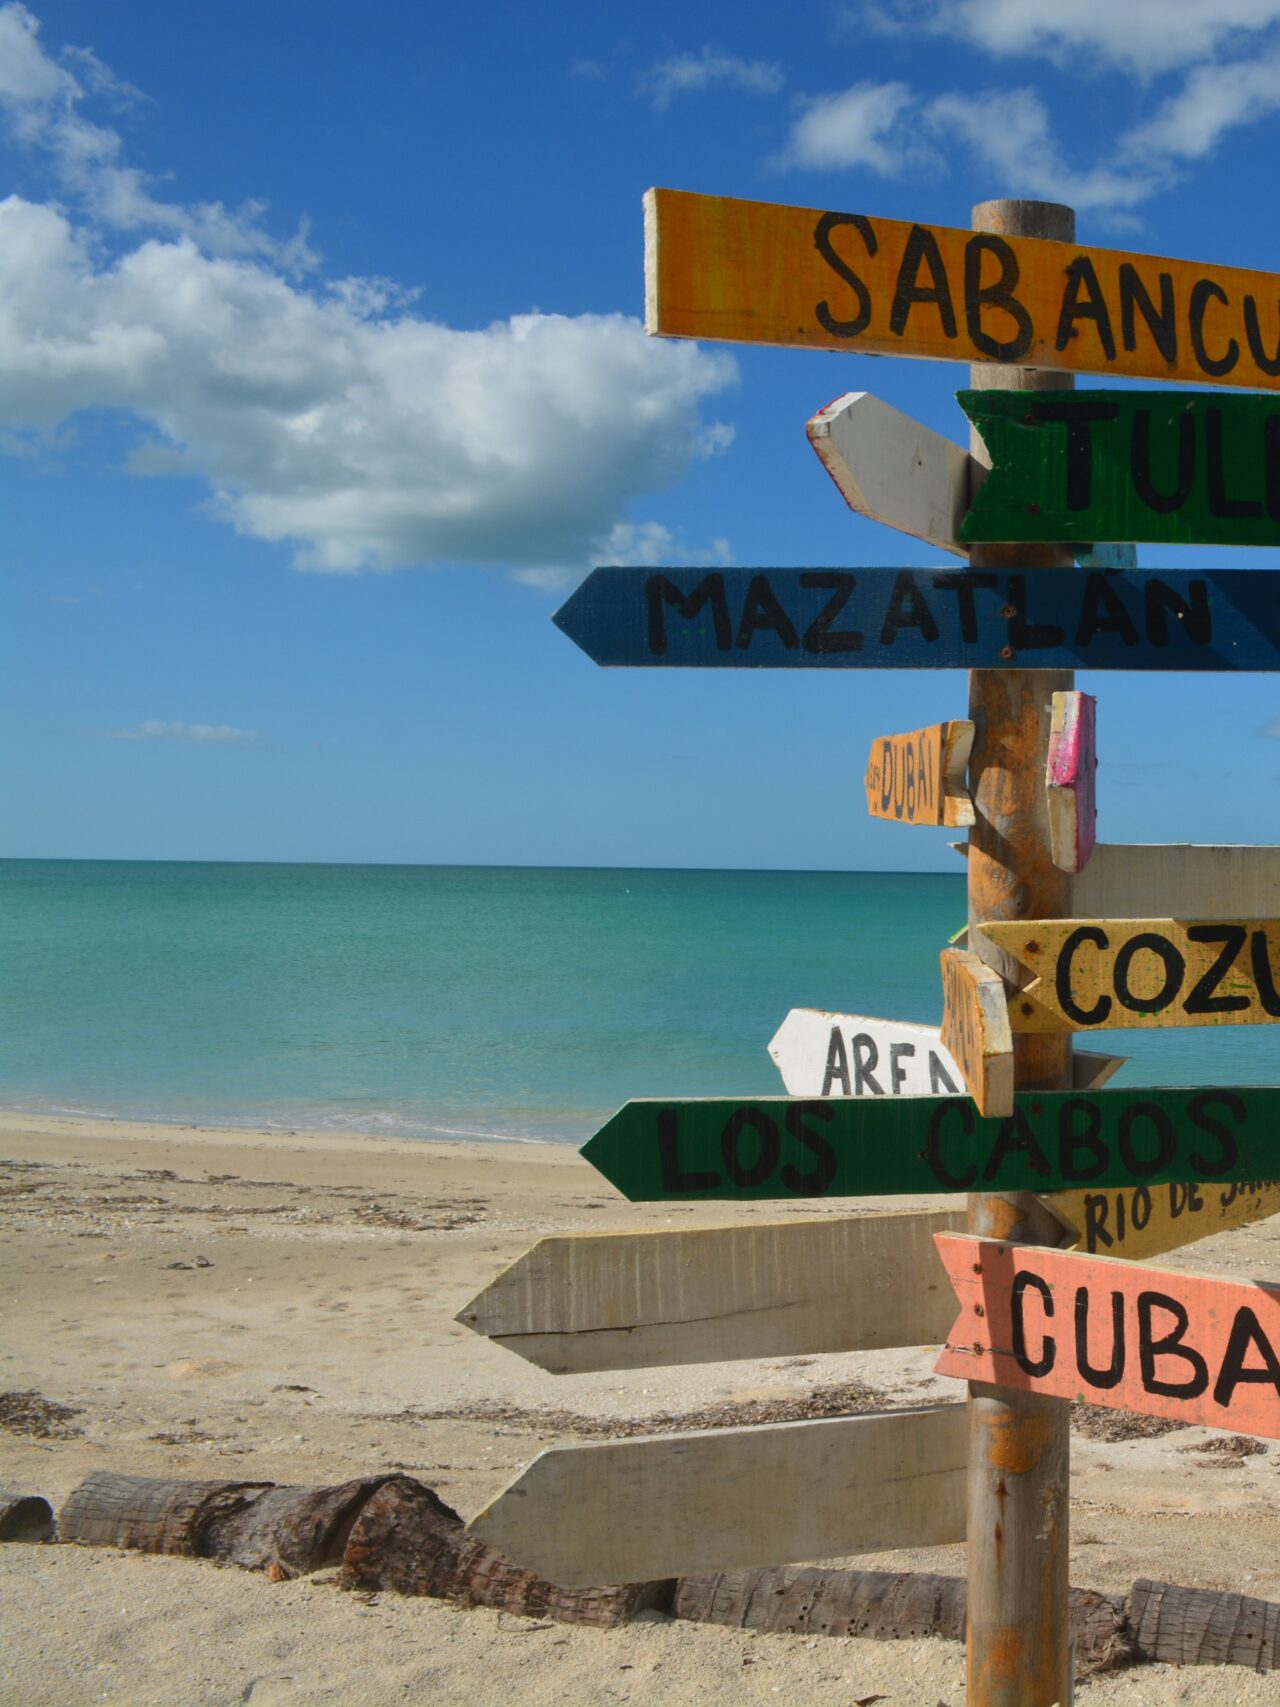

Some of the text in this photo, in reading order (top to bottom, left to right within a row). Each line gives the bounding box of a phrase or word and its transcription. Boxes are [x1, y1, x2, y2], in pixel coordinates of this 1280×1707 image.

[881, 732, 934, 820] DUBAI
[658, 1088, 1248, 1197] LOS CABOS
[1084, 1186, 1151, 1254] RIO
